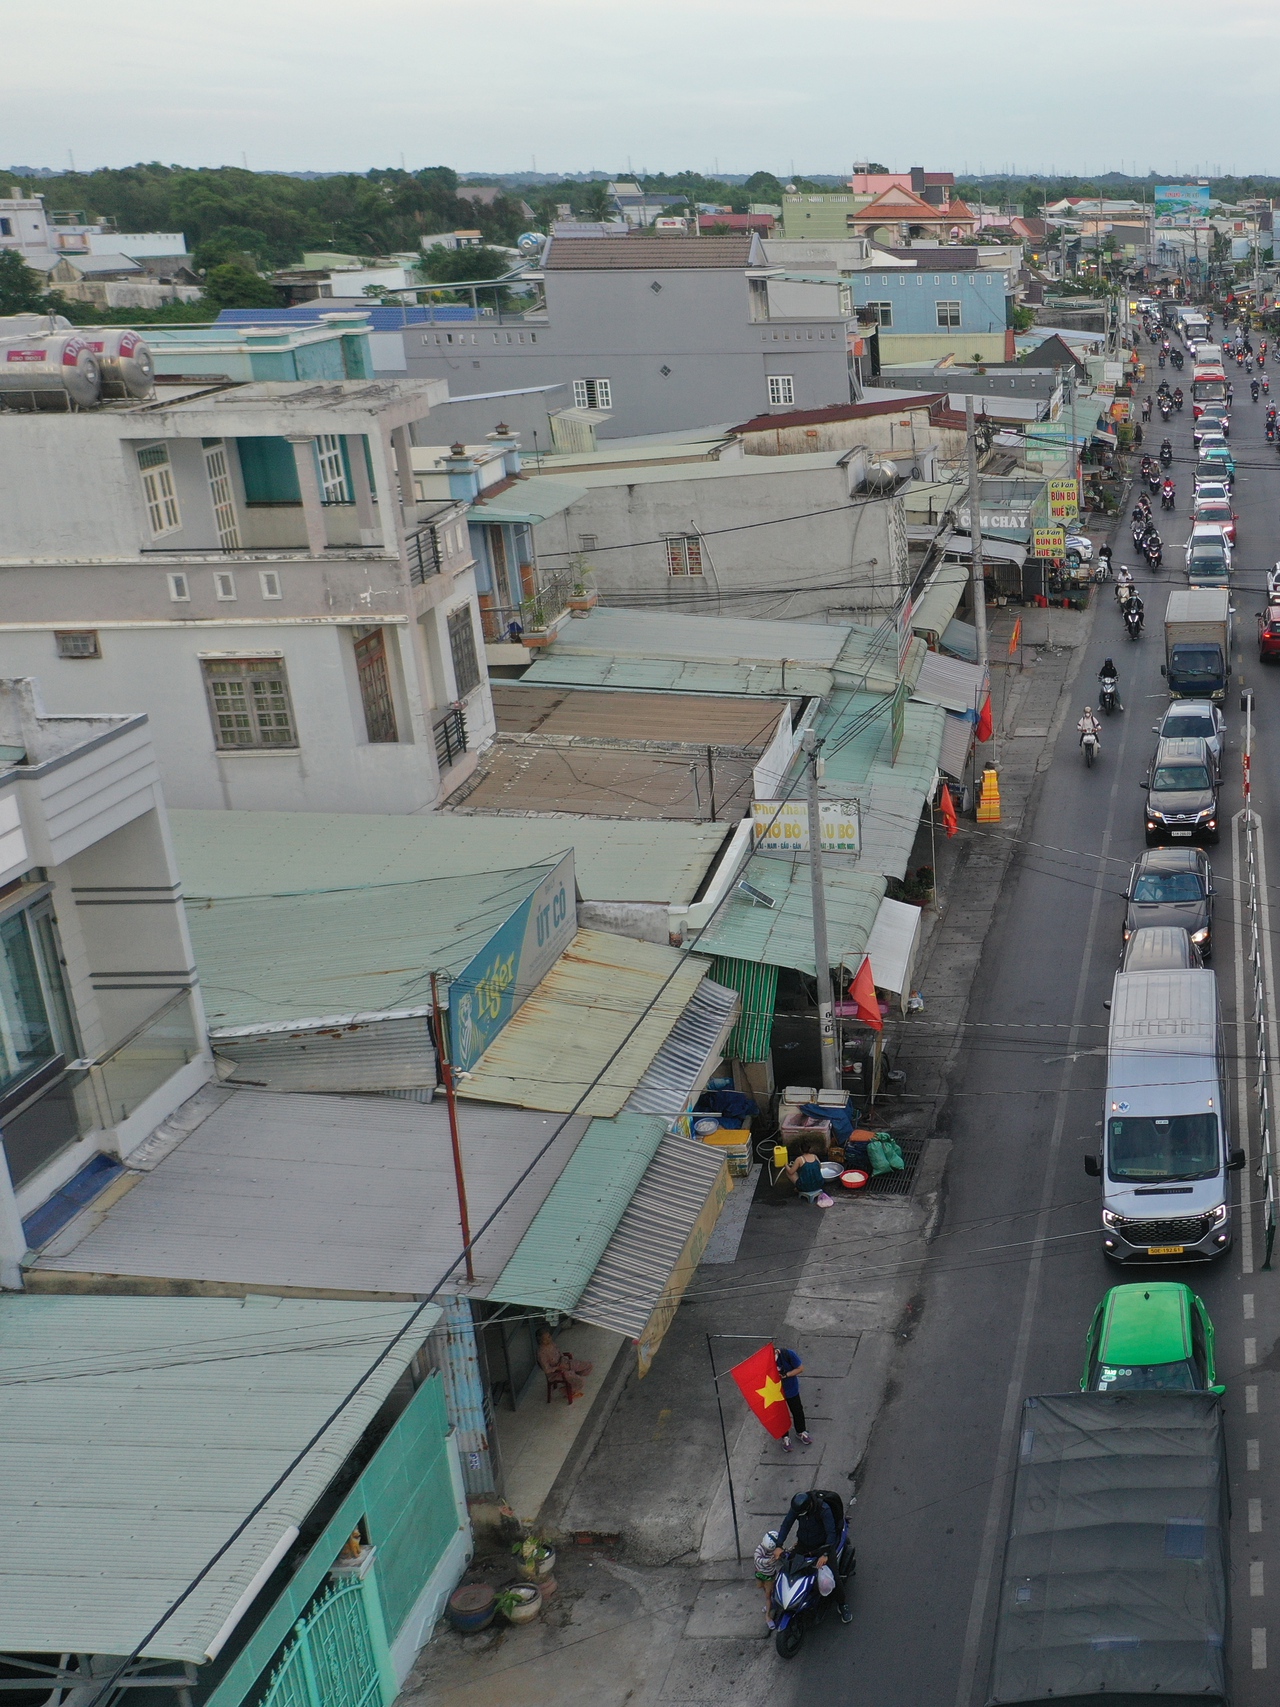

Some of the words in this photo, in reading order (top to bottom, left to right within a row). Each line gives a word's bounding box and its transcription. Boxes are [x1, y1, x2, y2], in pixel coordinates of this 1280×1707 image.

[960, 515, 988, 528] CM
[991, 516, 1028, 528] CHAY
[784, 820, 802, 839] BÒ
[838, 820, 855, 839] BÒ
[474, 951, 515, 1020] Tiger
